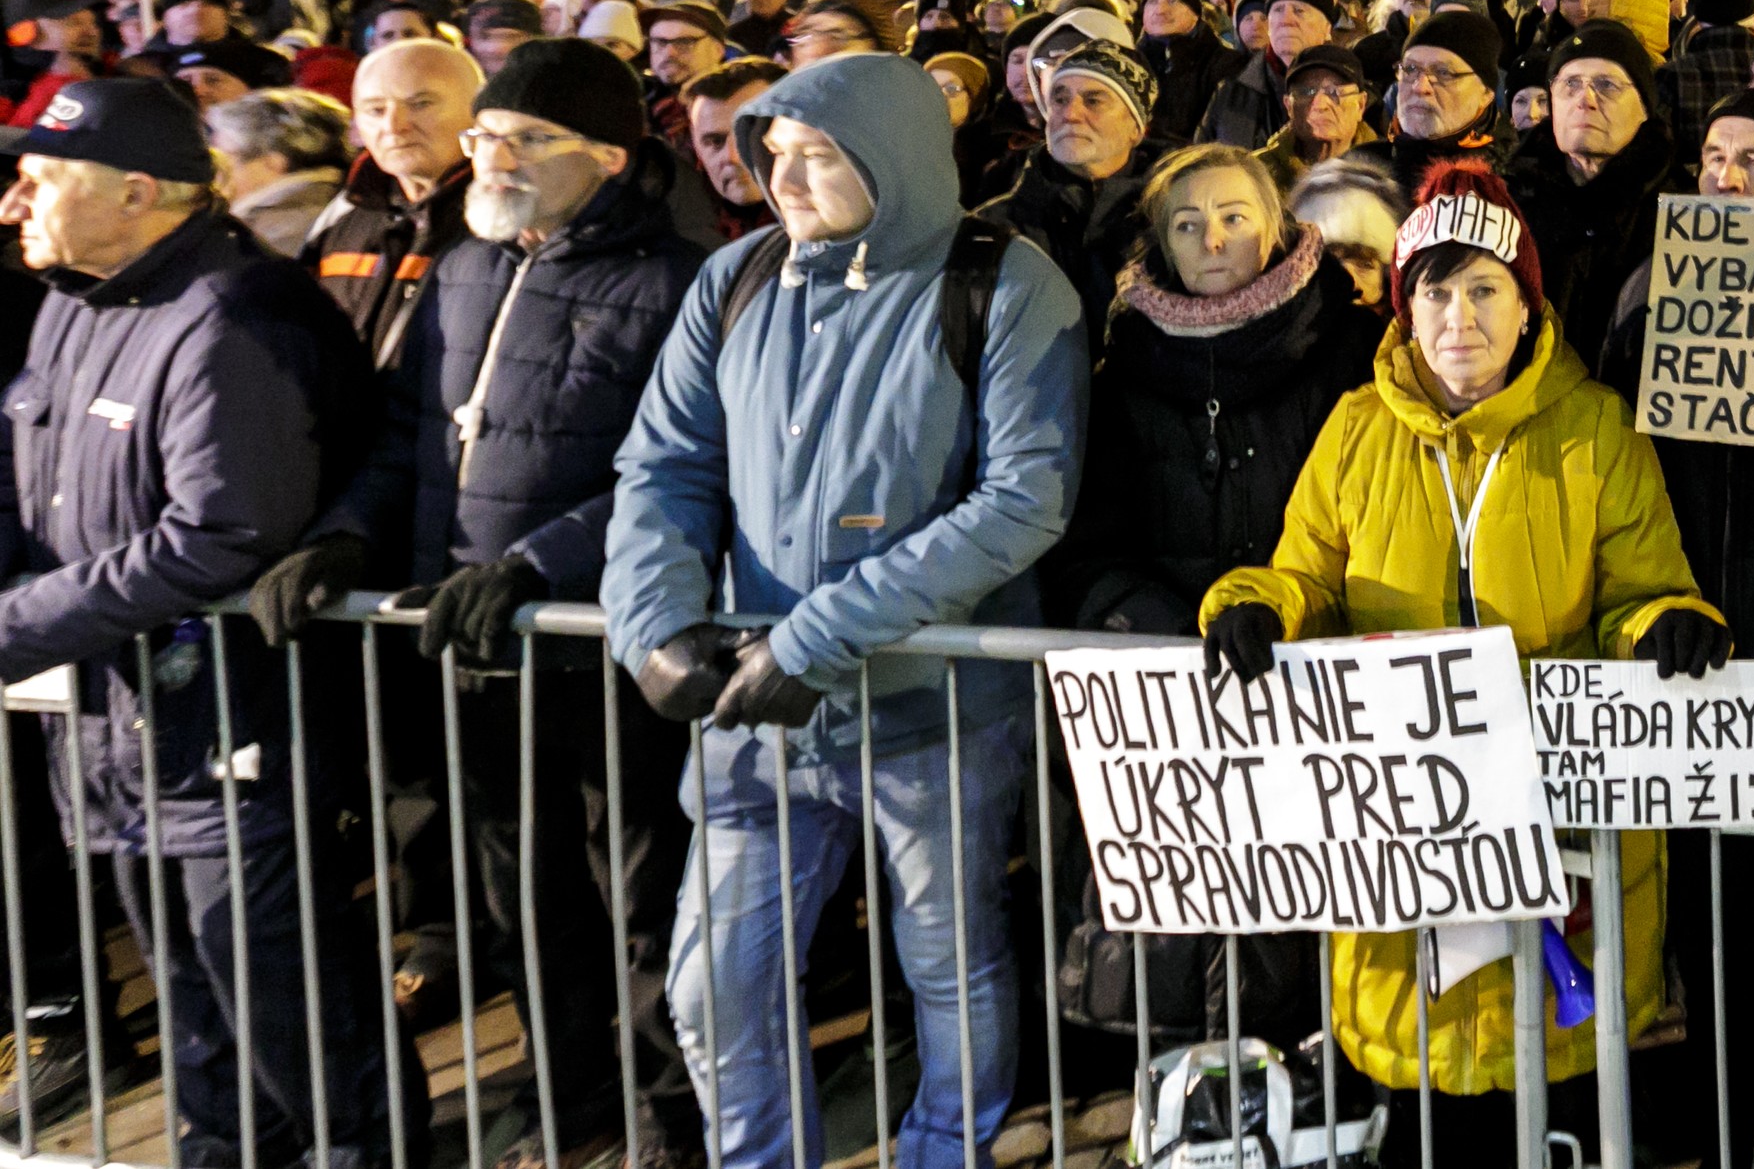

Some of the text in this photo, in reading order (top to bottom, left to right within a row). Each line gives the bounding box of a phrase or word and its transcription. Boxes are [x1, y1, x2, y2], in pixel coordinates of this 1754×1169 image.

[1664, 202, 1749, 246] KDE
[1390, 648, 1488, 741] JE
[1534, 663, 1602, 699] KDE
[1536, 689, 1674, 749] VLÁDA
[1535, 749, 1606, 777] TAM
[1100, 752, 1470, 845] ÚKRYT PRED
[1542, 774, 1674, 825] MAFIA
[1098, 821, 1561, 927] SPRAVODLIVOSŤOU
